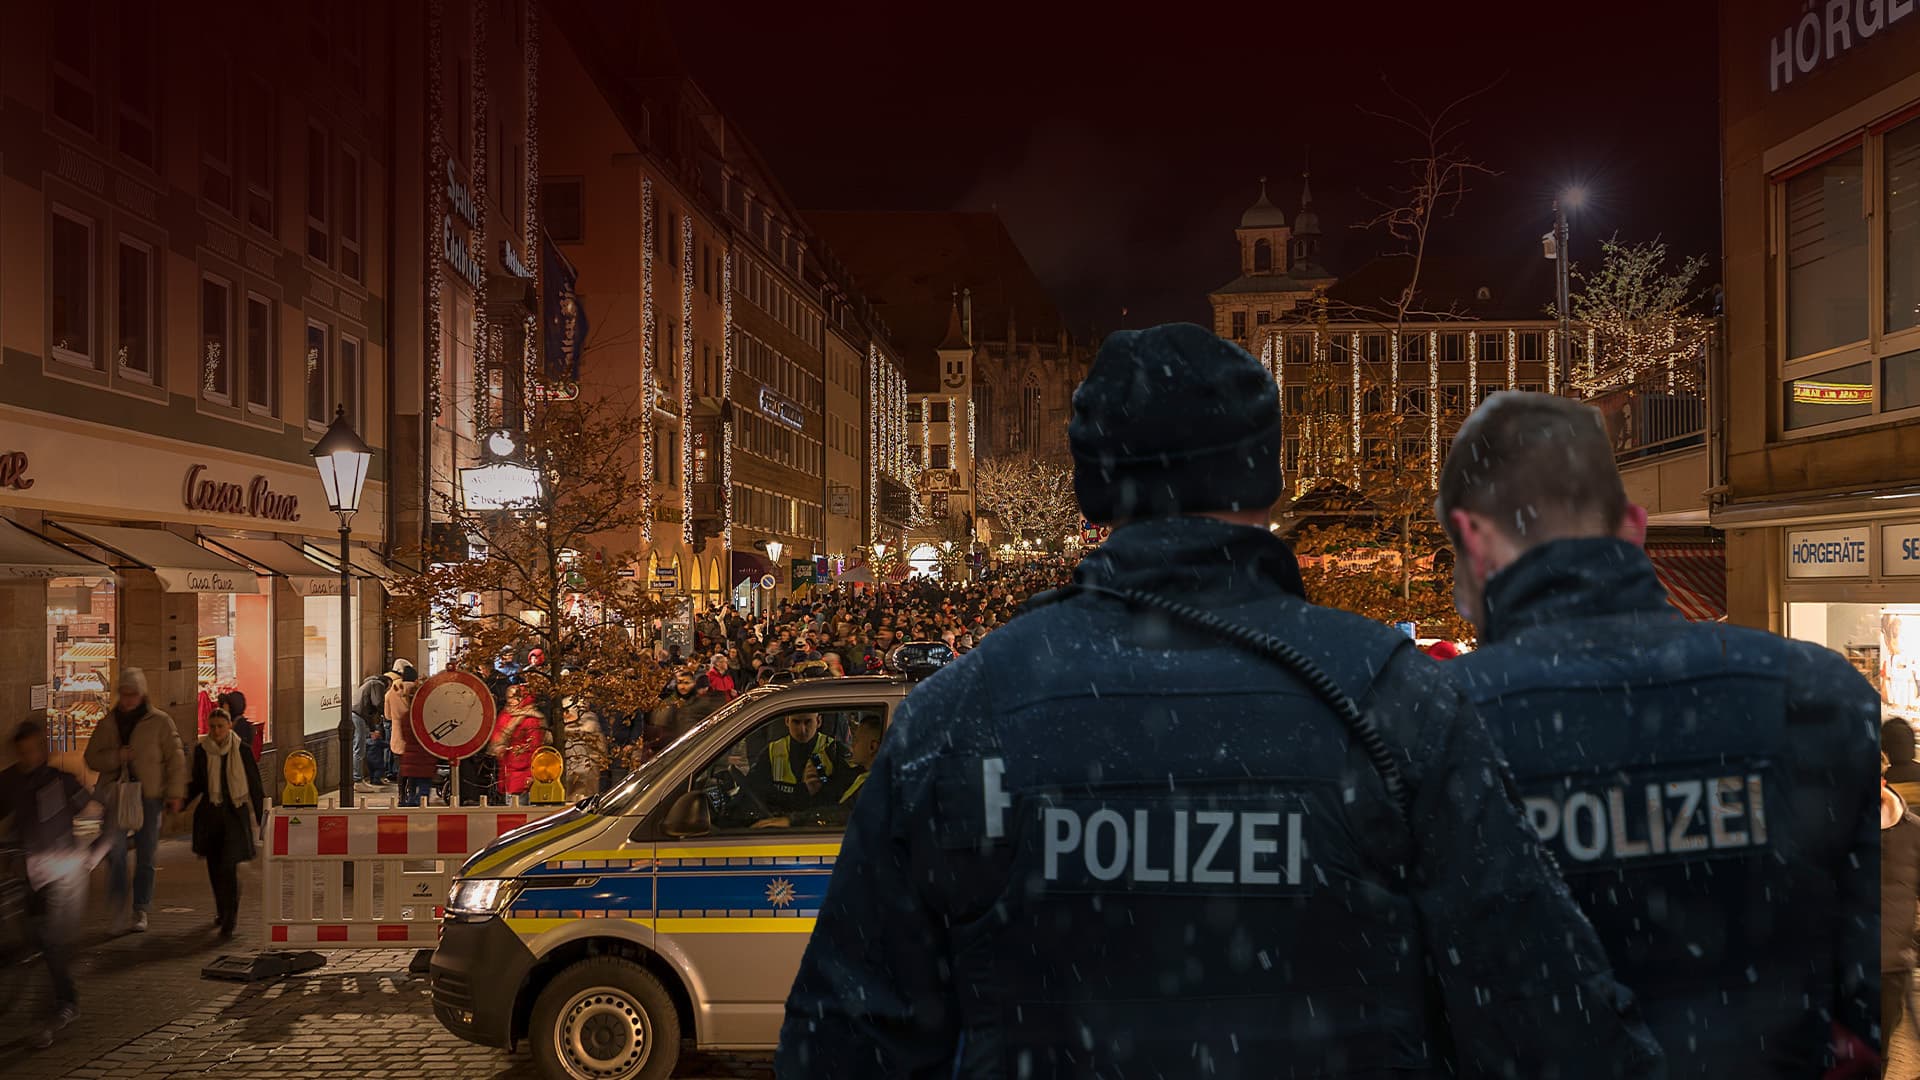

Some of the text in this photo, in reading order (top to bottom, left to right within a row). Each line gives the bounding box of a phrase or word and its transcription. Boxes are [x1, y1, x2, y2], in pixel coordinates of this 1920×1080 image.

[184, 463, 301, 522] Casa Pane
[1792, 536, 1866, 564] HÖRGERÄTE
[1902, 537, 1920, 561] SE
[186, 571, 235, 591] Casa Pane
[310, 579, 328, 594] Casa
[1523, 774, 1769, 862] POLIZEI
[1043, 807, 1302, 885] POLIZEI
